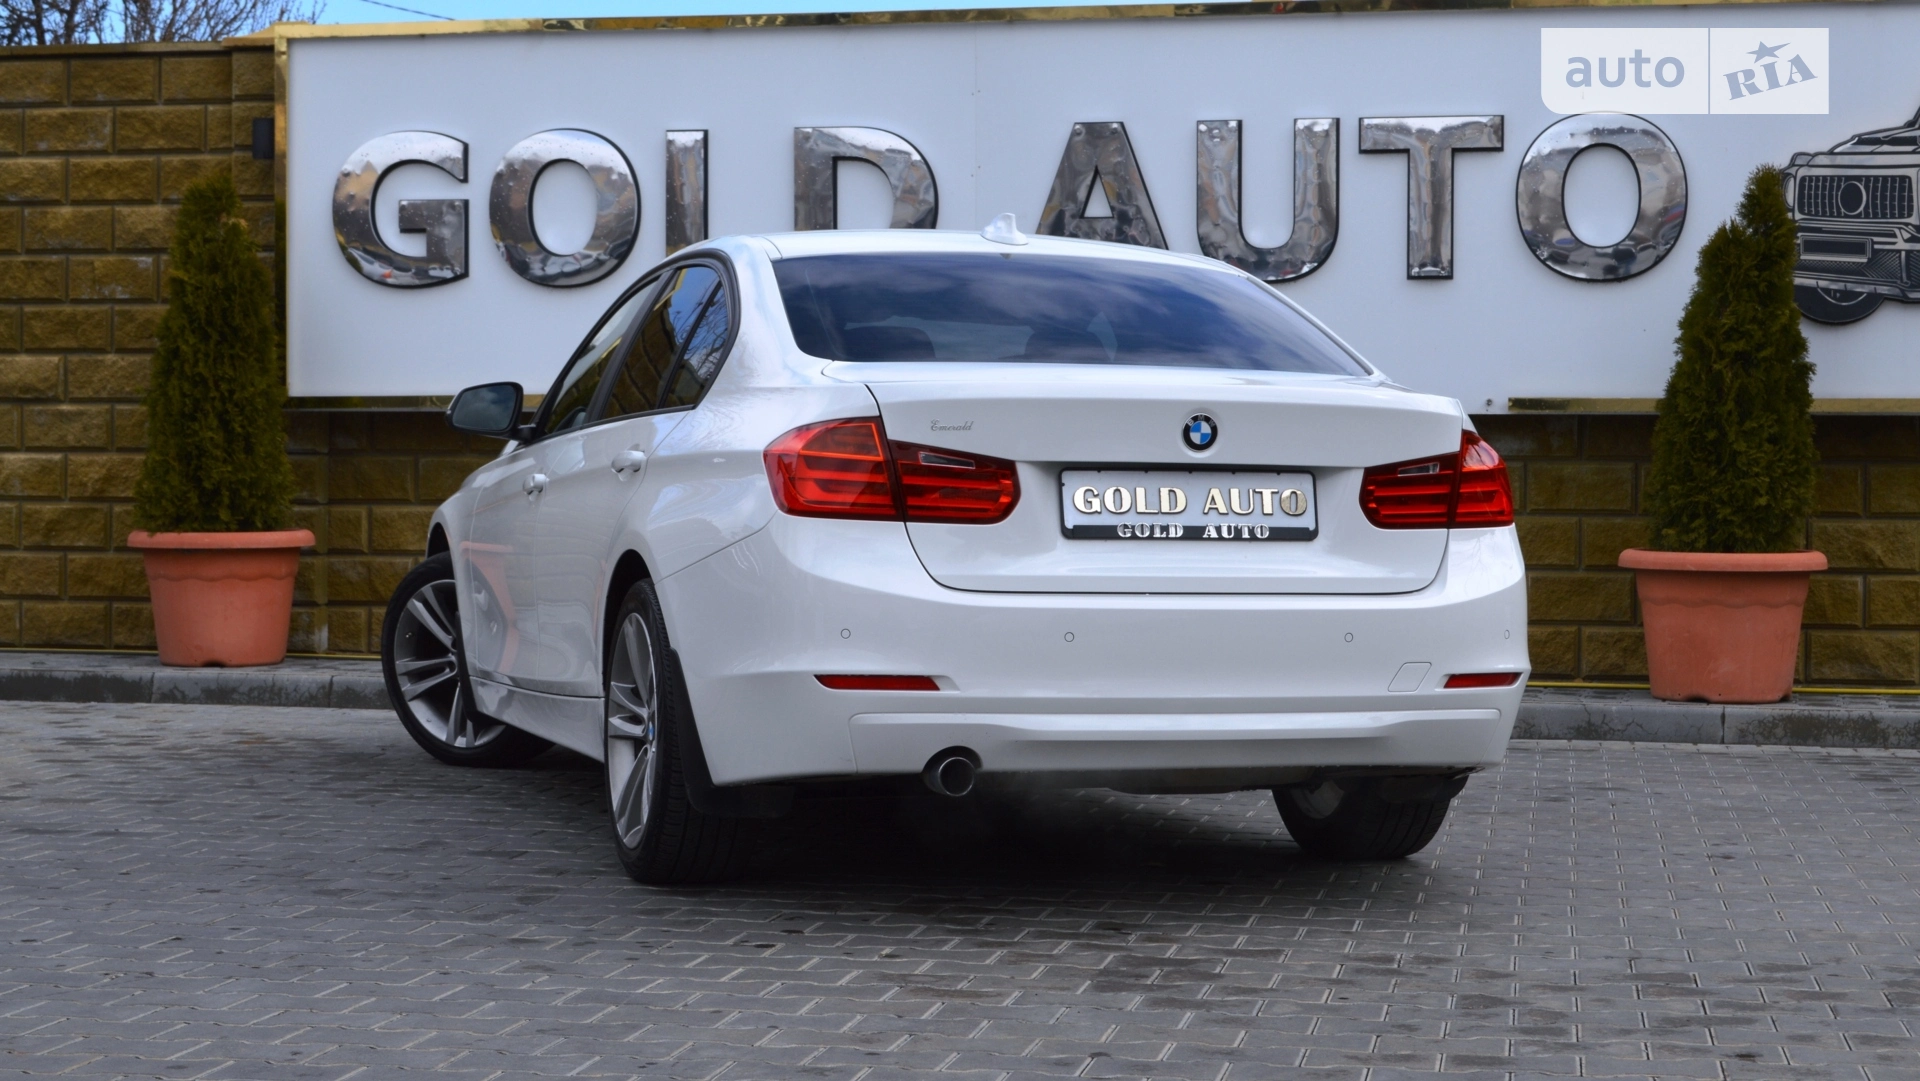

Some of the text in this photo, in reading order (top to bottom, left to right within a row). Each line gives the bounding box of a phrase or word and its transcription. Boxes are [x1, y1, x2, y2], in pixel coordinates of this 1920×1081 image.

[1037, 112, 1688, 283] AUTO
[930, 418, 974, 432] Emerald
[1073, 486, 1308, 516] GOLD AUTO
[1117, 522, 1270, 539] GOLD AUTO
